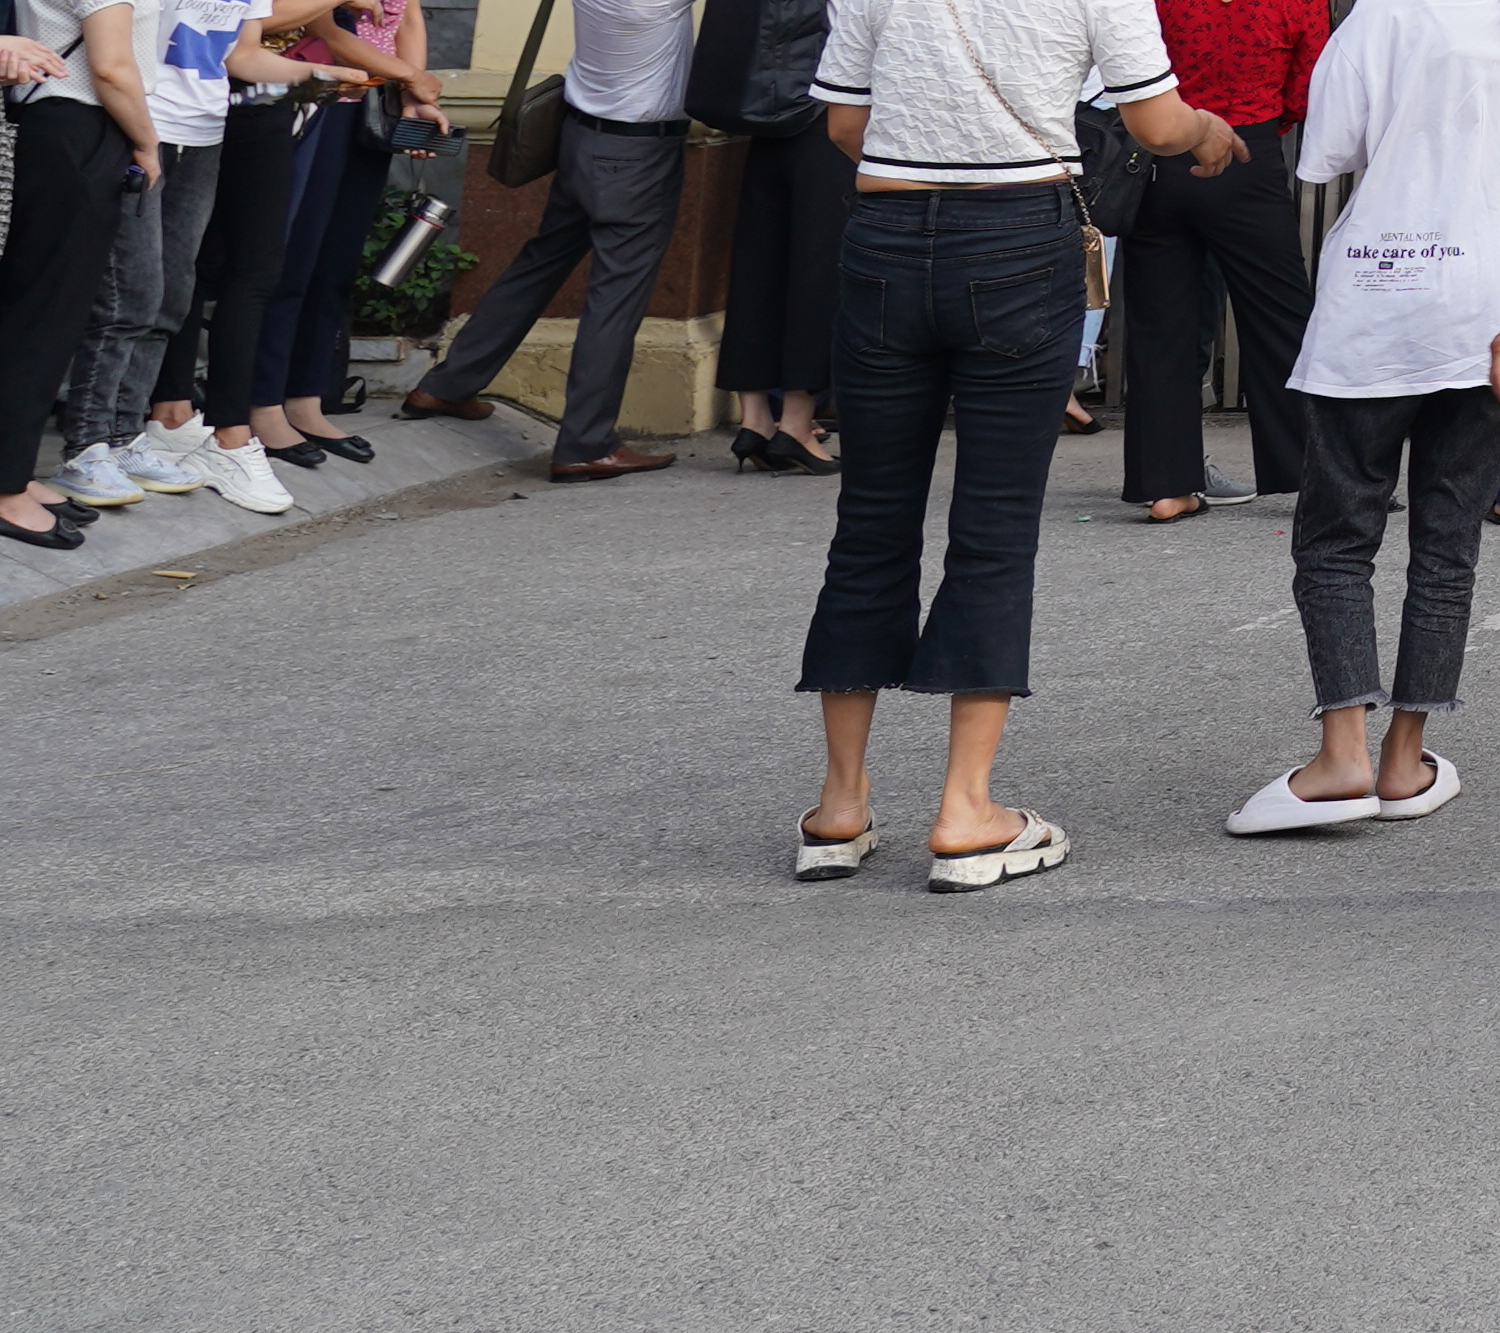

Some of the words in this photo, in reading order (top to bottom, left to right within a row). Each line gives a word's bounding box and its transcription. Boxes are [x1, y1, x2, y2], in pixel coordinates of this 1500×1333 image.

[1380, 232, 1414, 242] MENTAL
[1347, 245, 1379, 259] take
[1382, 248, 1416, 259] care
[1420, 244, 1438, 259] of
[1438, 246, 1465, 261] you.
